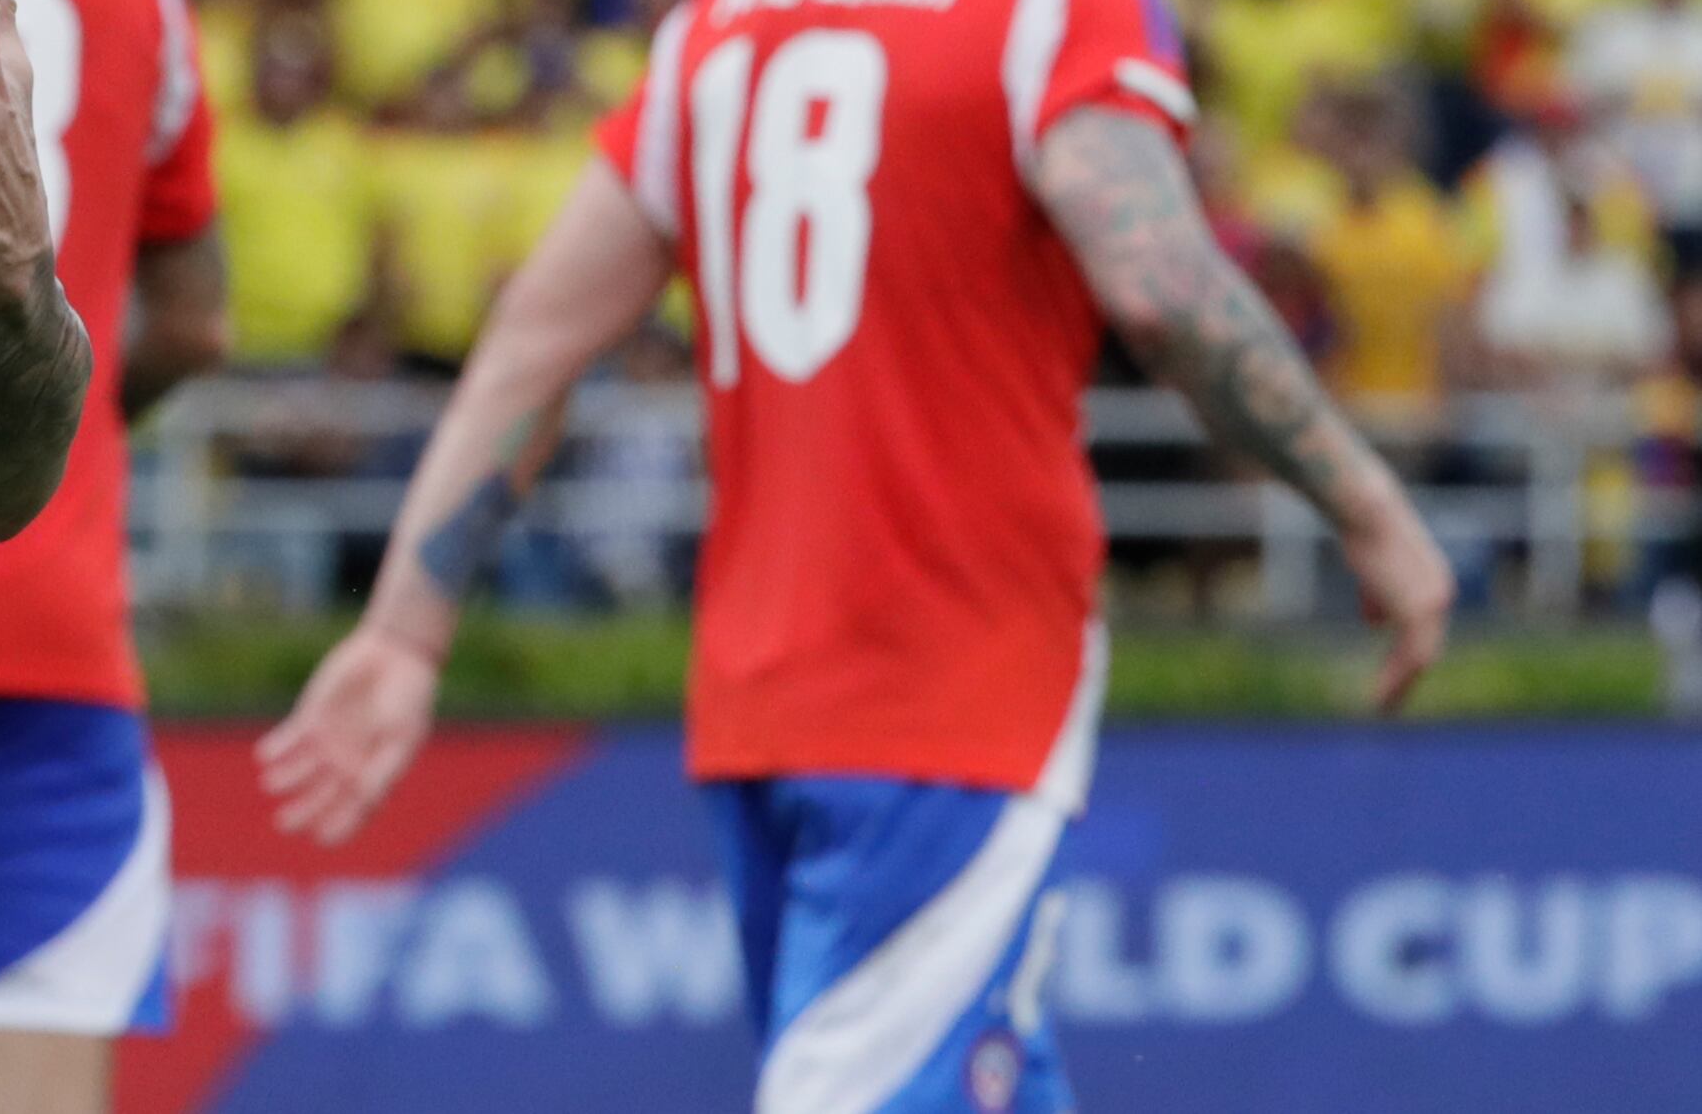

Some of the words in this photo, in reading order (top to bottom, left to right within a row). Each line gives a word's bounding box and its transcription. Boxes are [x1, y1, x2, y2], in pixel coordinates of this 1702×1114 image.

[690, 28, 886, 389] 18
[566, 878, 1305, 1024] WLD
[1332, 878, 1702, 1024] CUP
